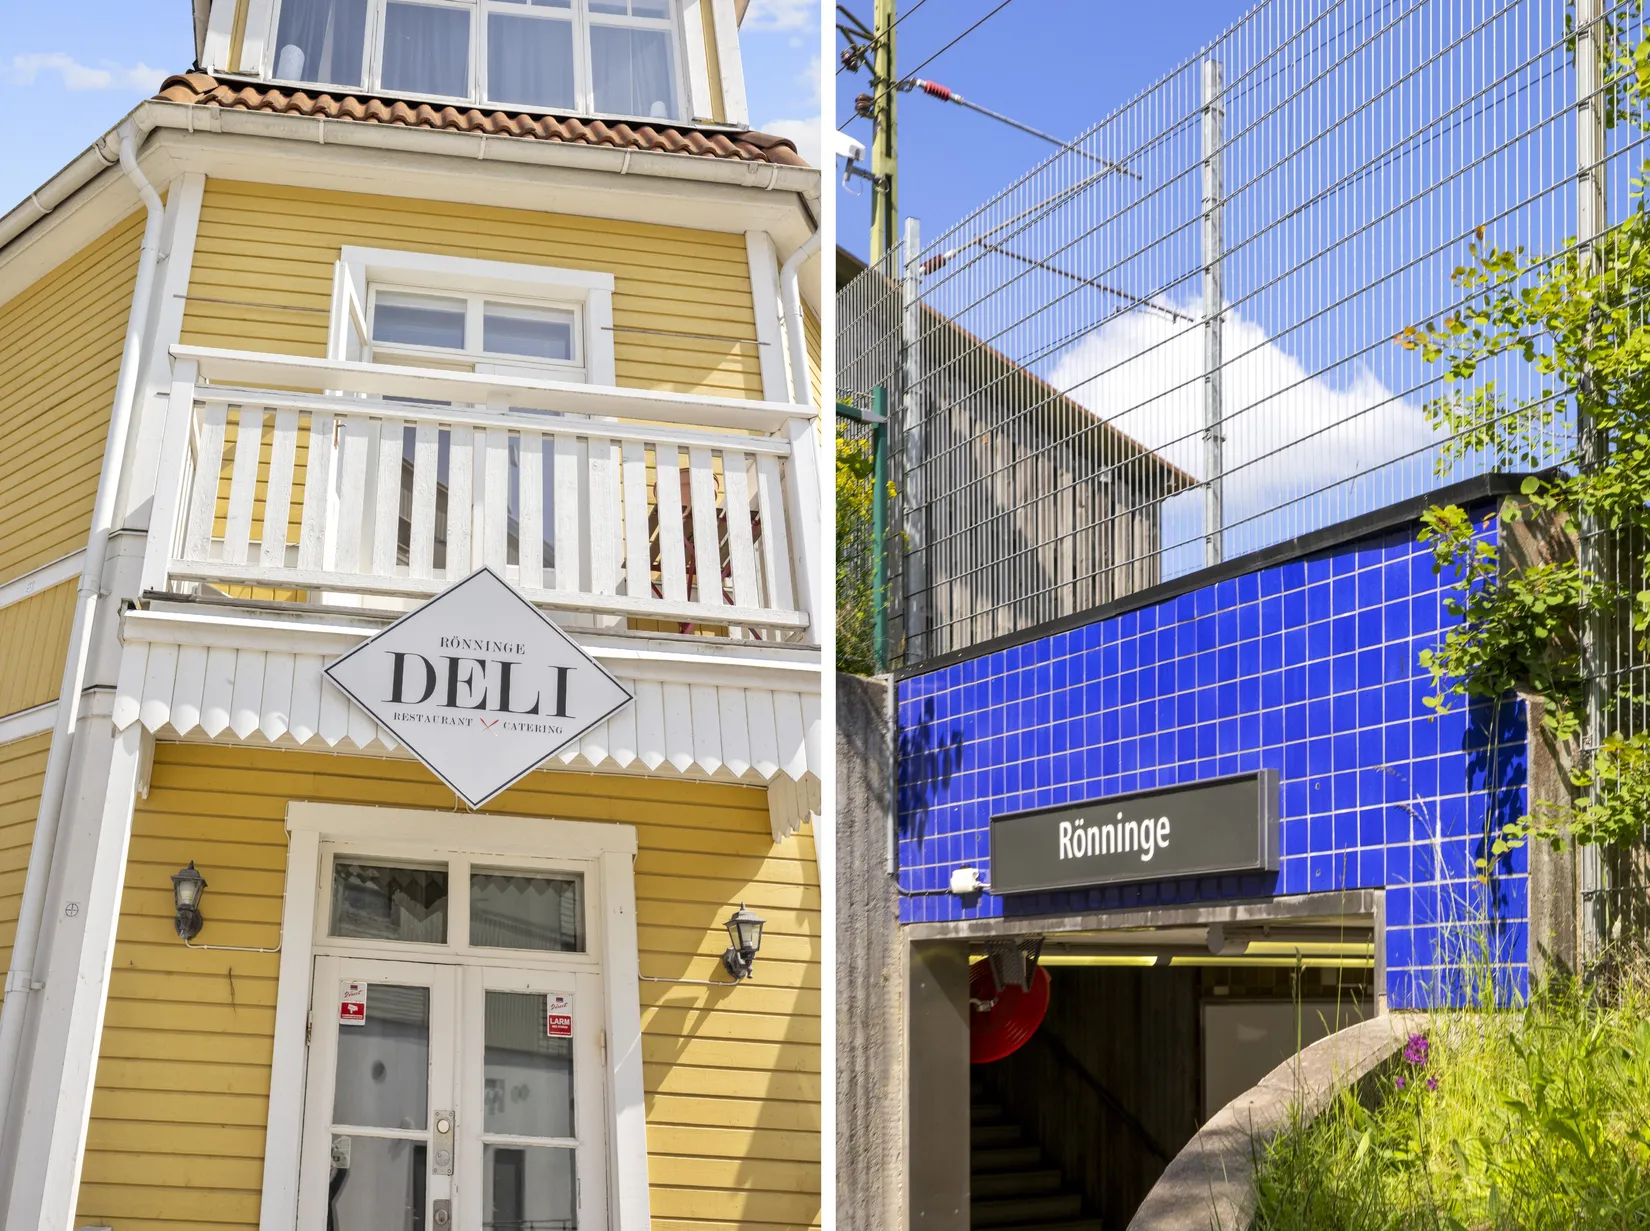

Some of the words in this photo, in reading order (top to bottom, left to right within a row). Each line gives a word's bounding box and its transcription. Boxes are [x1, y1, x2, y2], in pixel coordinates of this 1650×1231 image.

[440, 636, 525, 655] RÖNNINGE
[381, 651, 577, 718] DELI
[393, 712, 473, 727] RESTAURANT
[503, 721, 563, 734] CATERING
[1059, 811, 1170, 861] Rönninge
